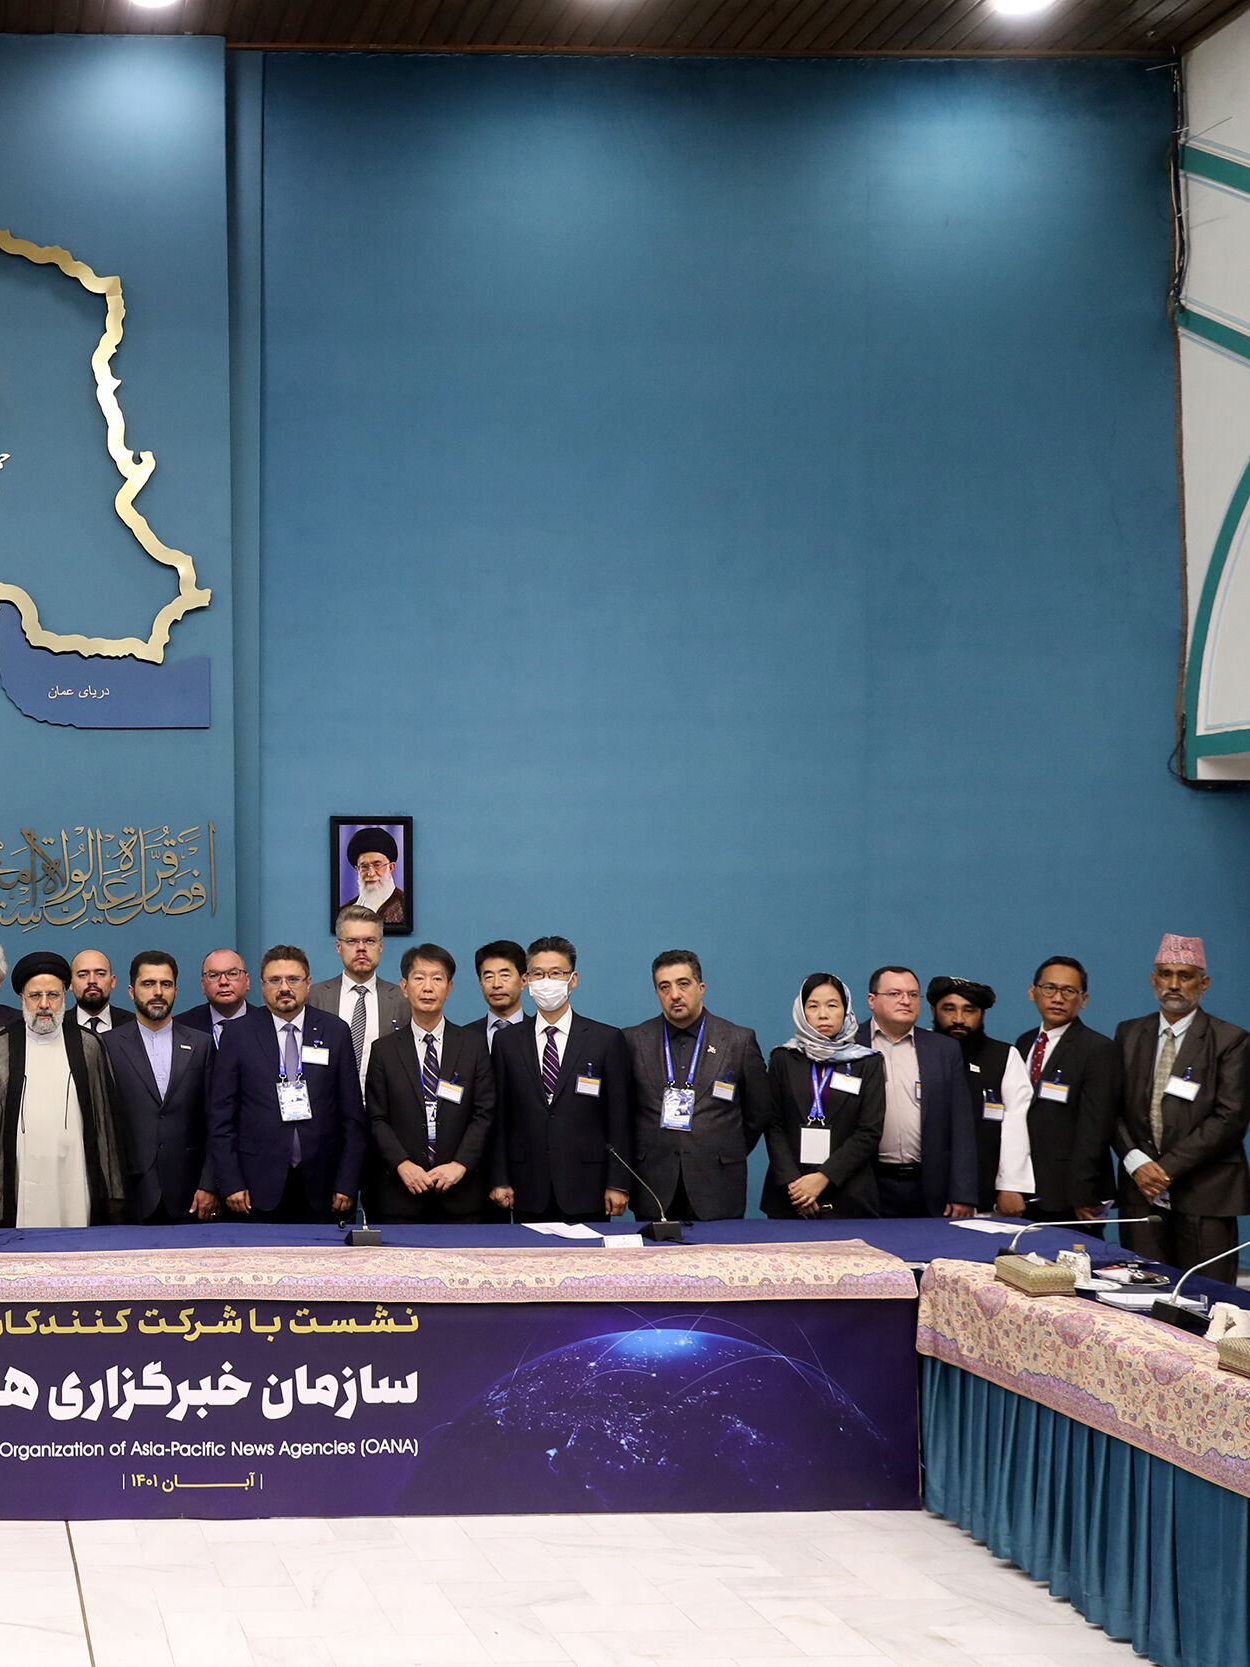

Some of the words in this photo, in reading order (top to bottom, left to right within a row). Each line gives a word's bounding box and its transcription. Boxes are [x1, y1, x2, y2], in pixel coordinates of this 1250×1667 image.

[47, 685, 74, 699] عمان
[78, 685, 110, 699] دریای
[139, 1305, 241, 1341] شرکت
[250, 1308, 281, 1341] با
[290, 1305, 418, 1333] نشست
[49, 1361, 252, 1421] خبرگزاری
[262, 1364, 417, 1419] سازمان
[0, 1442, 104, 1460] Organization
[110, 1441, 126, 1455] of
[131, 1441, 225, 1456] Asia-Pacific
[232, 1442, 274, 1456] News
[279, 1440, 355, 1458] Agencies
[361, 1439, 418, 1457] (OANA)
[132, 1474, 157, 1487] ۱۴۰۱
[162, 1472, 255, 1492] آبان
